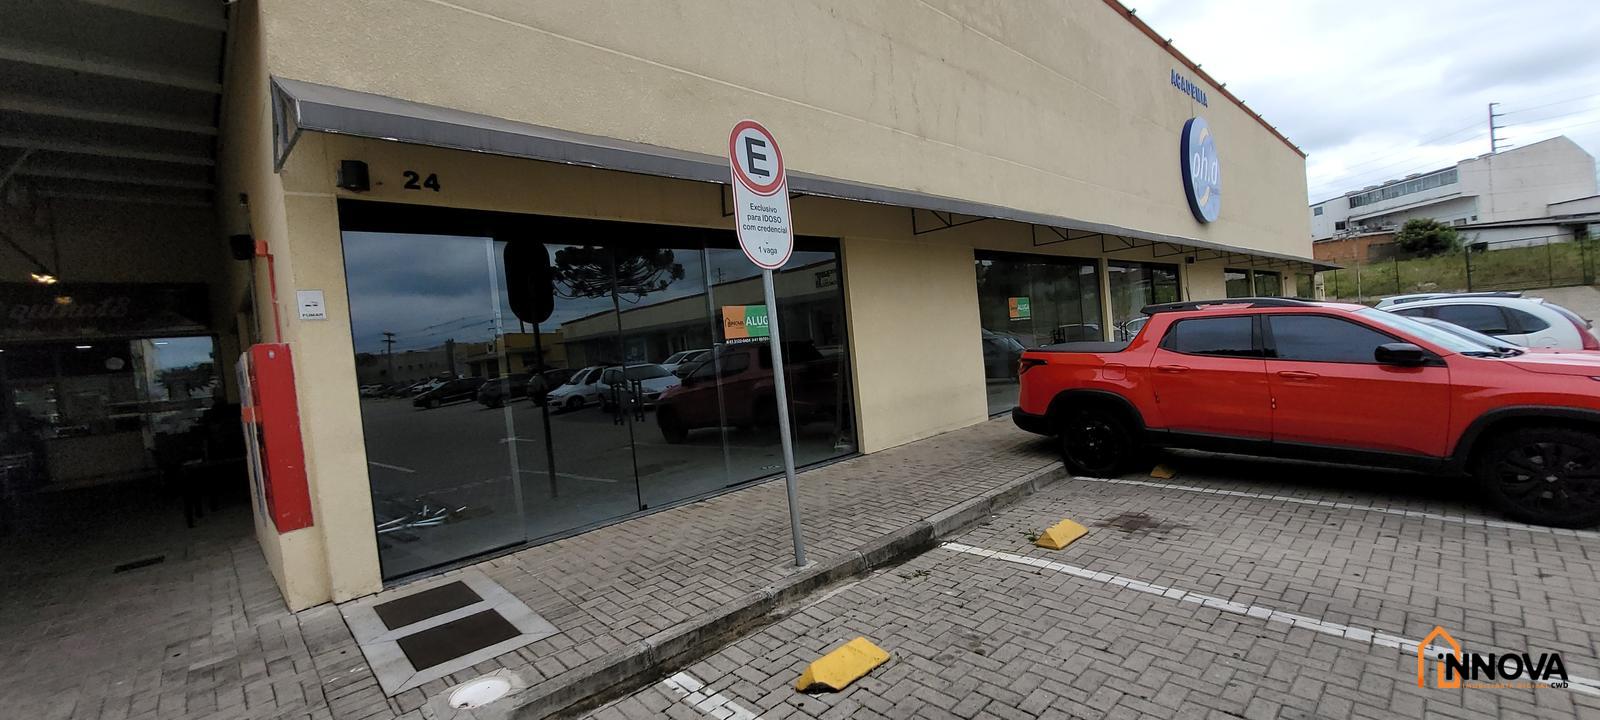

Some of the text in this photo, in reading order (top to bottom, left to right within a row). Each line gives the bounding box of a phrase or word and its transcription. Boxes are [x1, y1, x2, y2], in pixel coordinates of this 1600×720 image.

[744, 136, 770, 177] E
[403, 170, 440, 192] 24
[750, 203, 777, 213] Exclusivo
[747, 214, 782, 223] para IDOSO
[757, 225, 787, 234] credencial
[763, 247, 777, 255] vaga
[745, 315, 769, 326] ALUG
